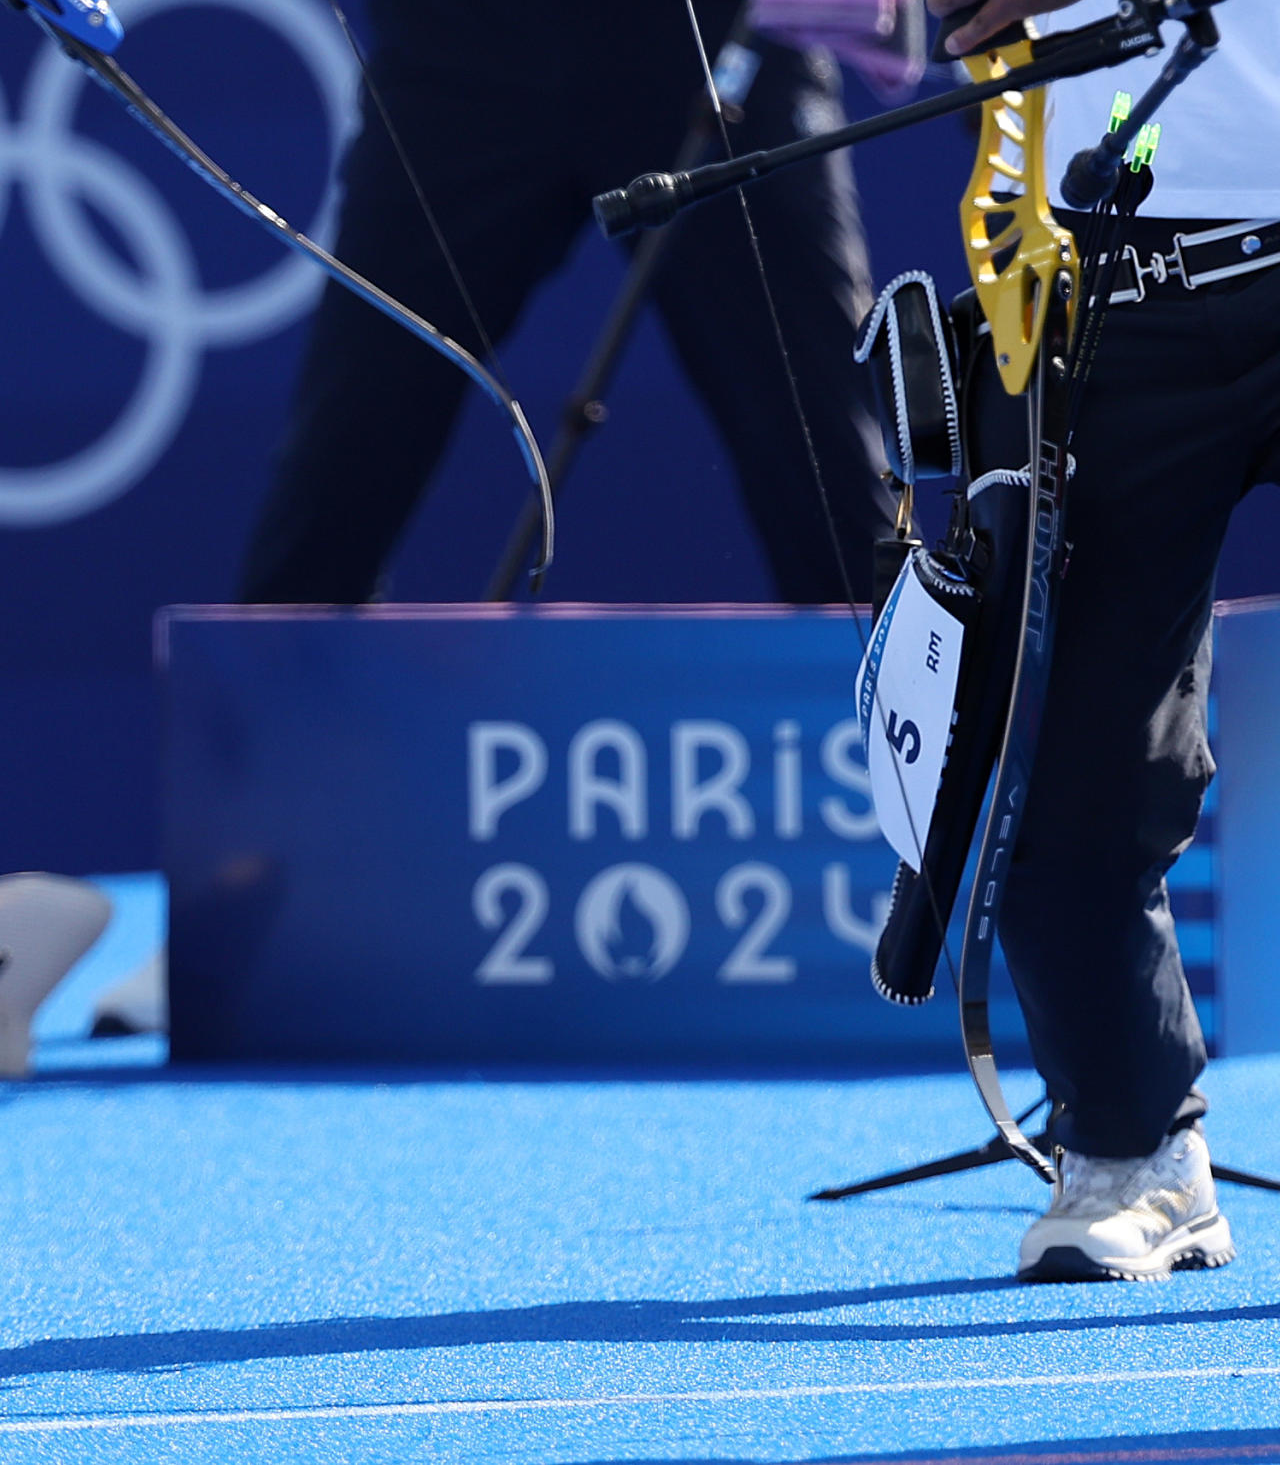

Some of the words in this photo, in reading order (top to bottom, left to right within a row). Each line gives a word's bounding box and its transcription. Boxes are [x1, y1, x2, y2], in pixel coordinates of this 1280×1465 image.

[924, 630, 943, 675] RM
[885, 708, 922, 765] 5
[977, 785, 1019, 941] VELOS
